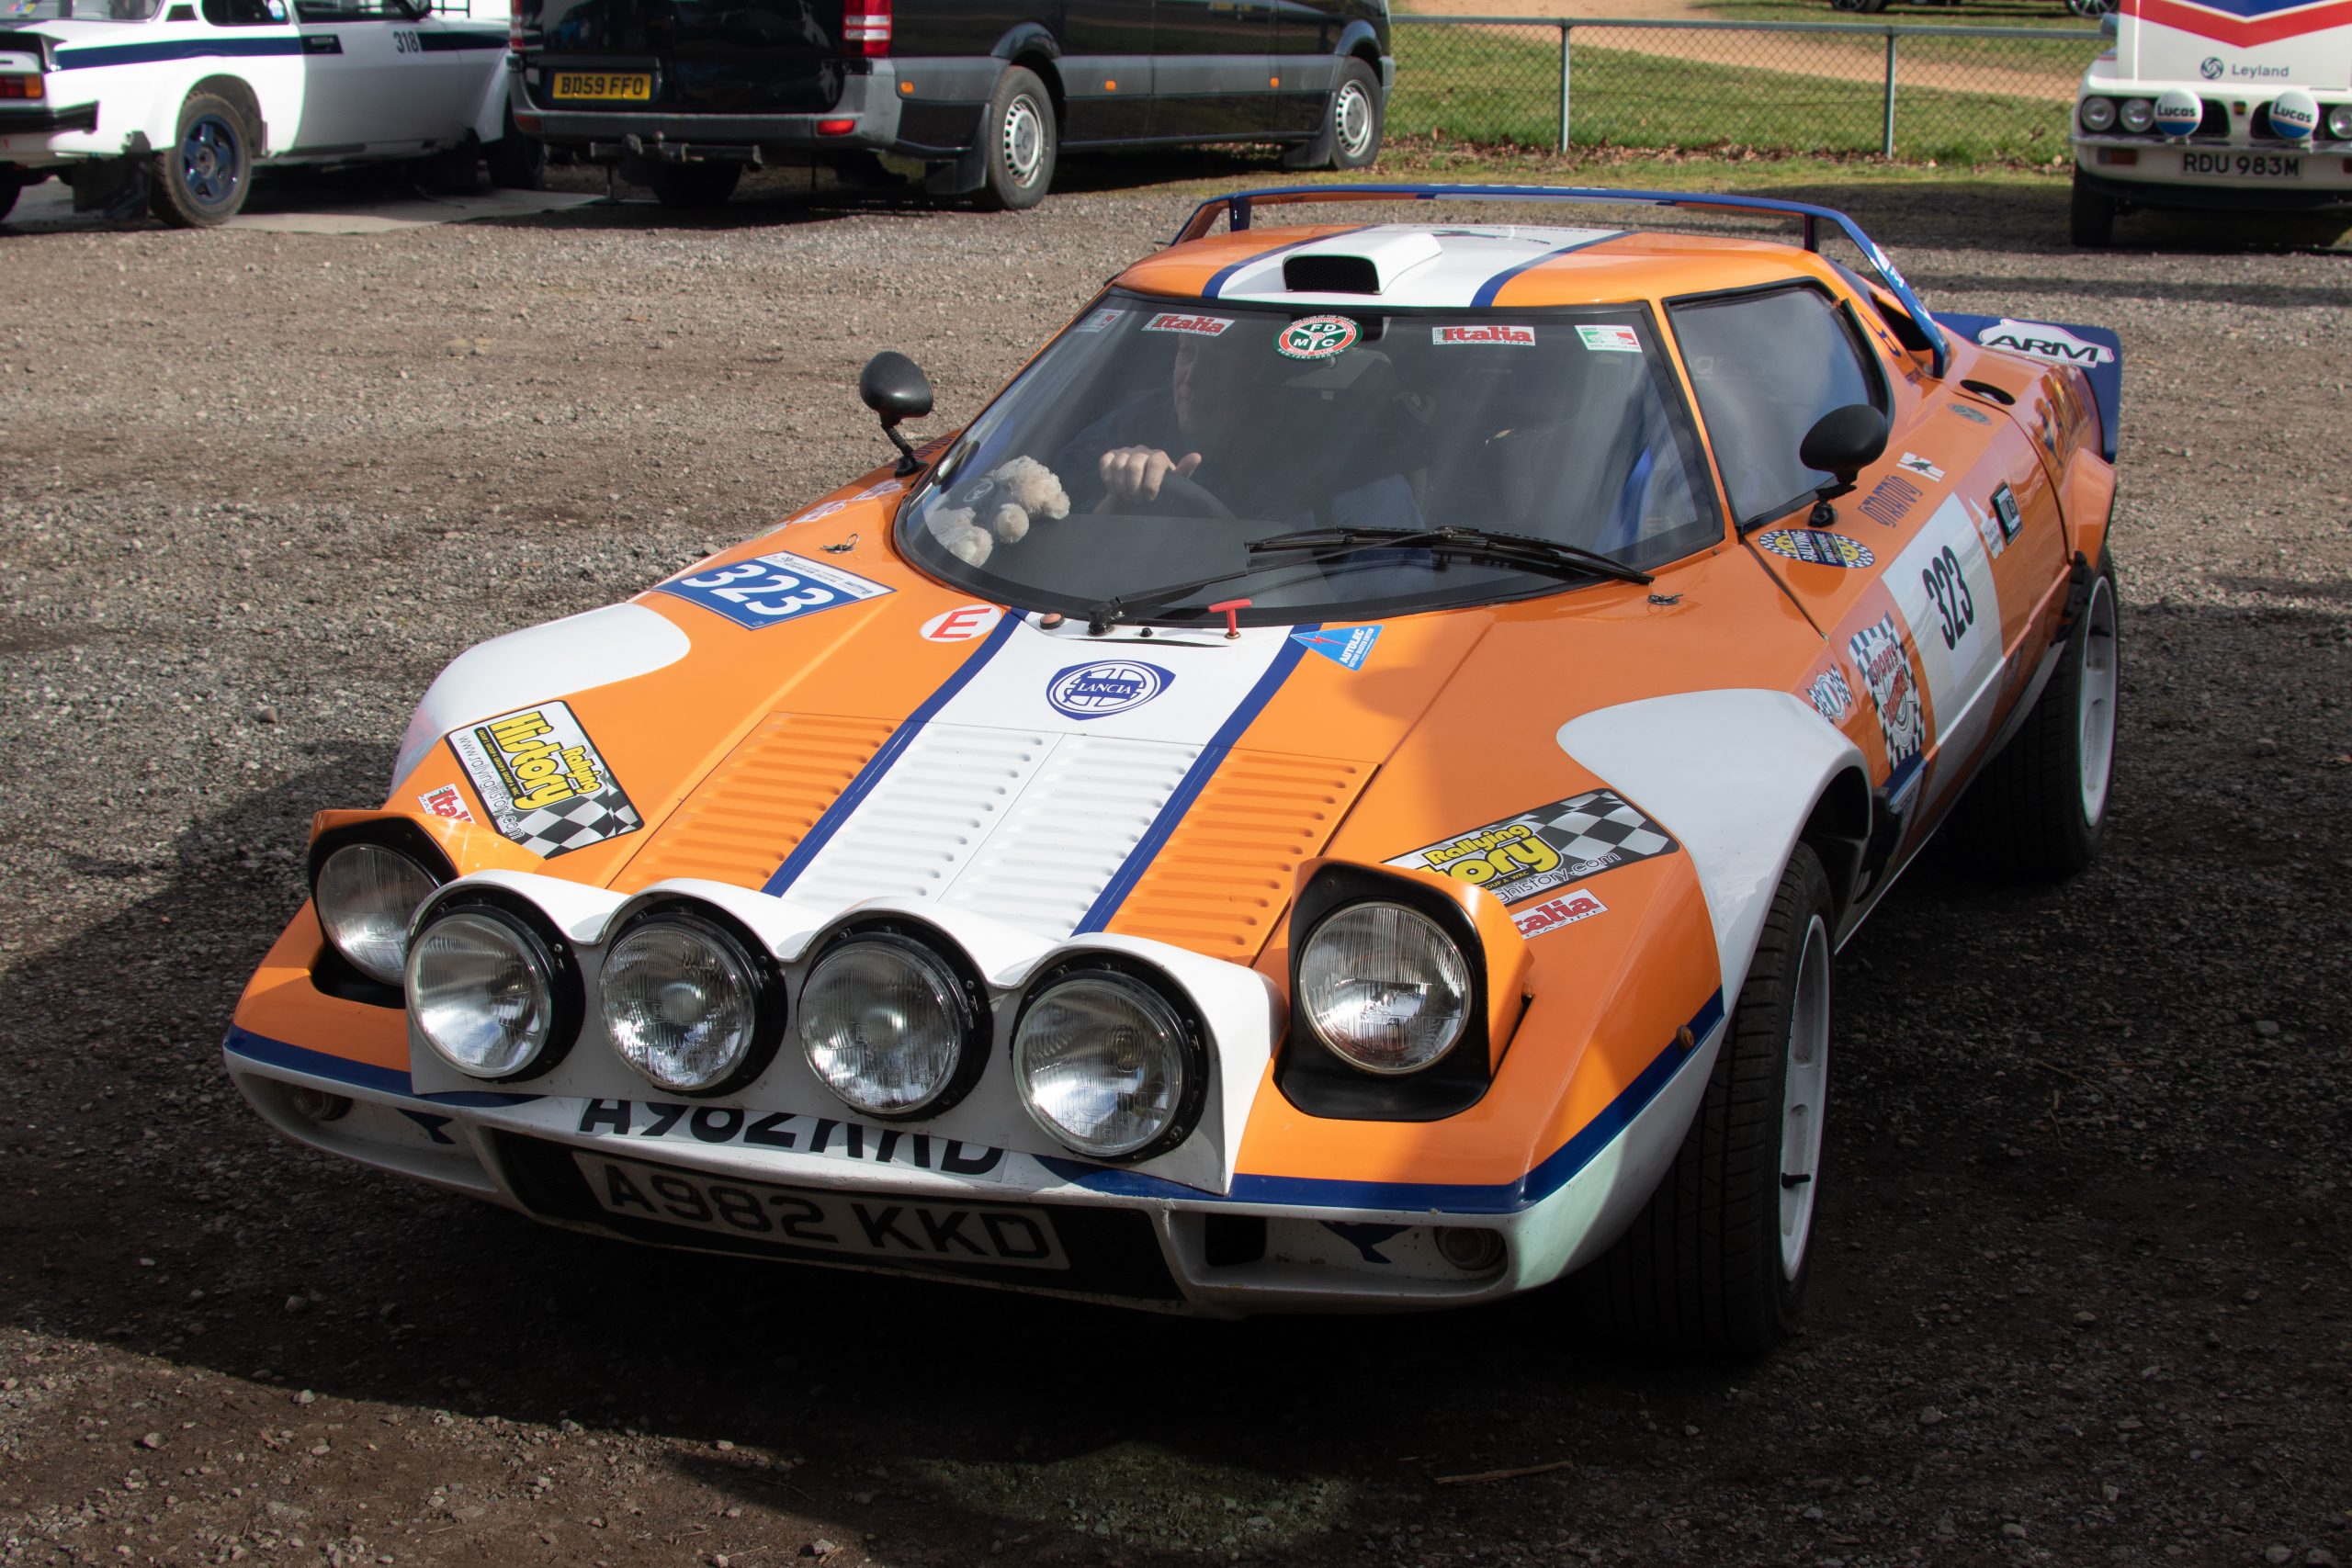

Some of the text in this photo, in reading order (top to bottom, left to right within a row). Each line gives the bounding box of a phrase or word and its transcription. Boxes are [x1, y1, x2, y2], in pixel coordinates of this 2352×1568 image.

[393, 30, 419, 53] 318
[561, 76, 605, 95] BD59
[2233, 64, 2289, 78] Leyland
[2156, 103, 2197, 118] Lucas
[2274, 102, 2312, 122] Lucas
[2183, 152, 2299, 176] RDU 983M
[1151, 315, 1226, 333] Italia
[1442, 327, 1532, 343] Italia
[1987, 334, 2099, 363] ARM
[1792, 531, 1818, 560] RALLYING
[681, 564, 835, 615] 323
[1922, 545, 1974, 651] 323
[929, 608, 991, 638] E
[1340, 628, 1365, 663] AUTOLEC
[1870, 642, 1899, 687] SPORTS
[1078, 682, 1133, 695] LANCIA
[487, 711, 578, 811] History
[561, 745, 603, 795] Rallying
[458, 734, 526, 840] www.rallyinghistory.com
[1422, 824, 1533, 865] Rallying
[604, 1164, 1051, 1260] A982 KKD
